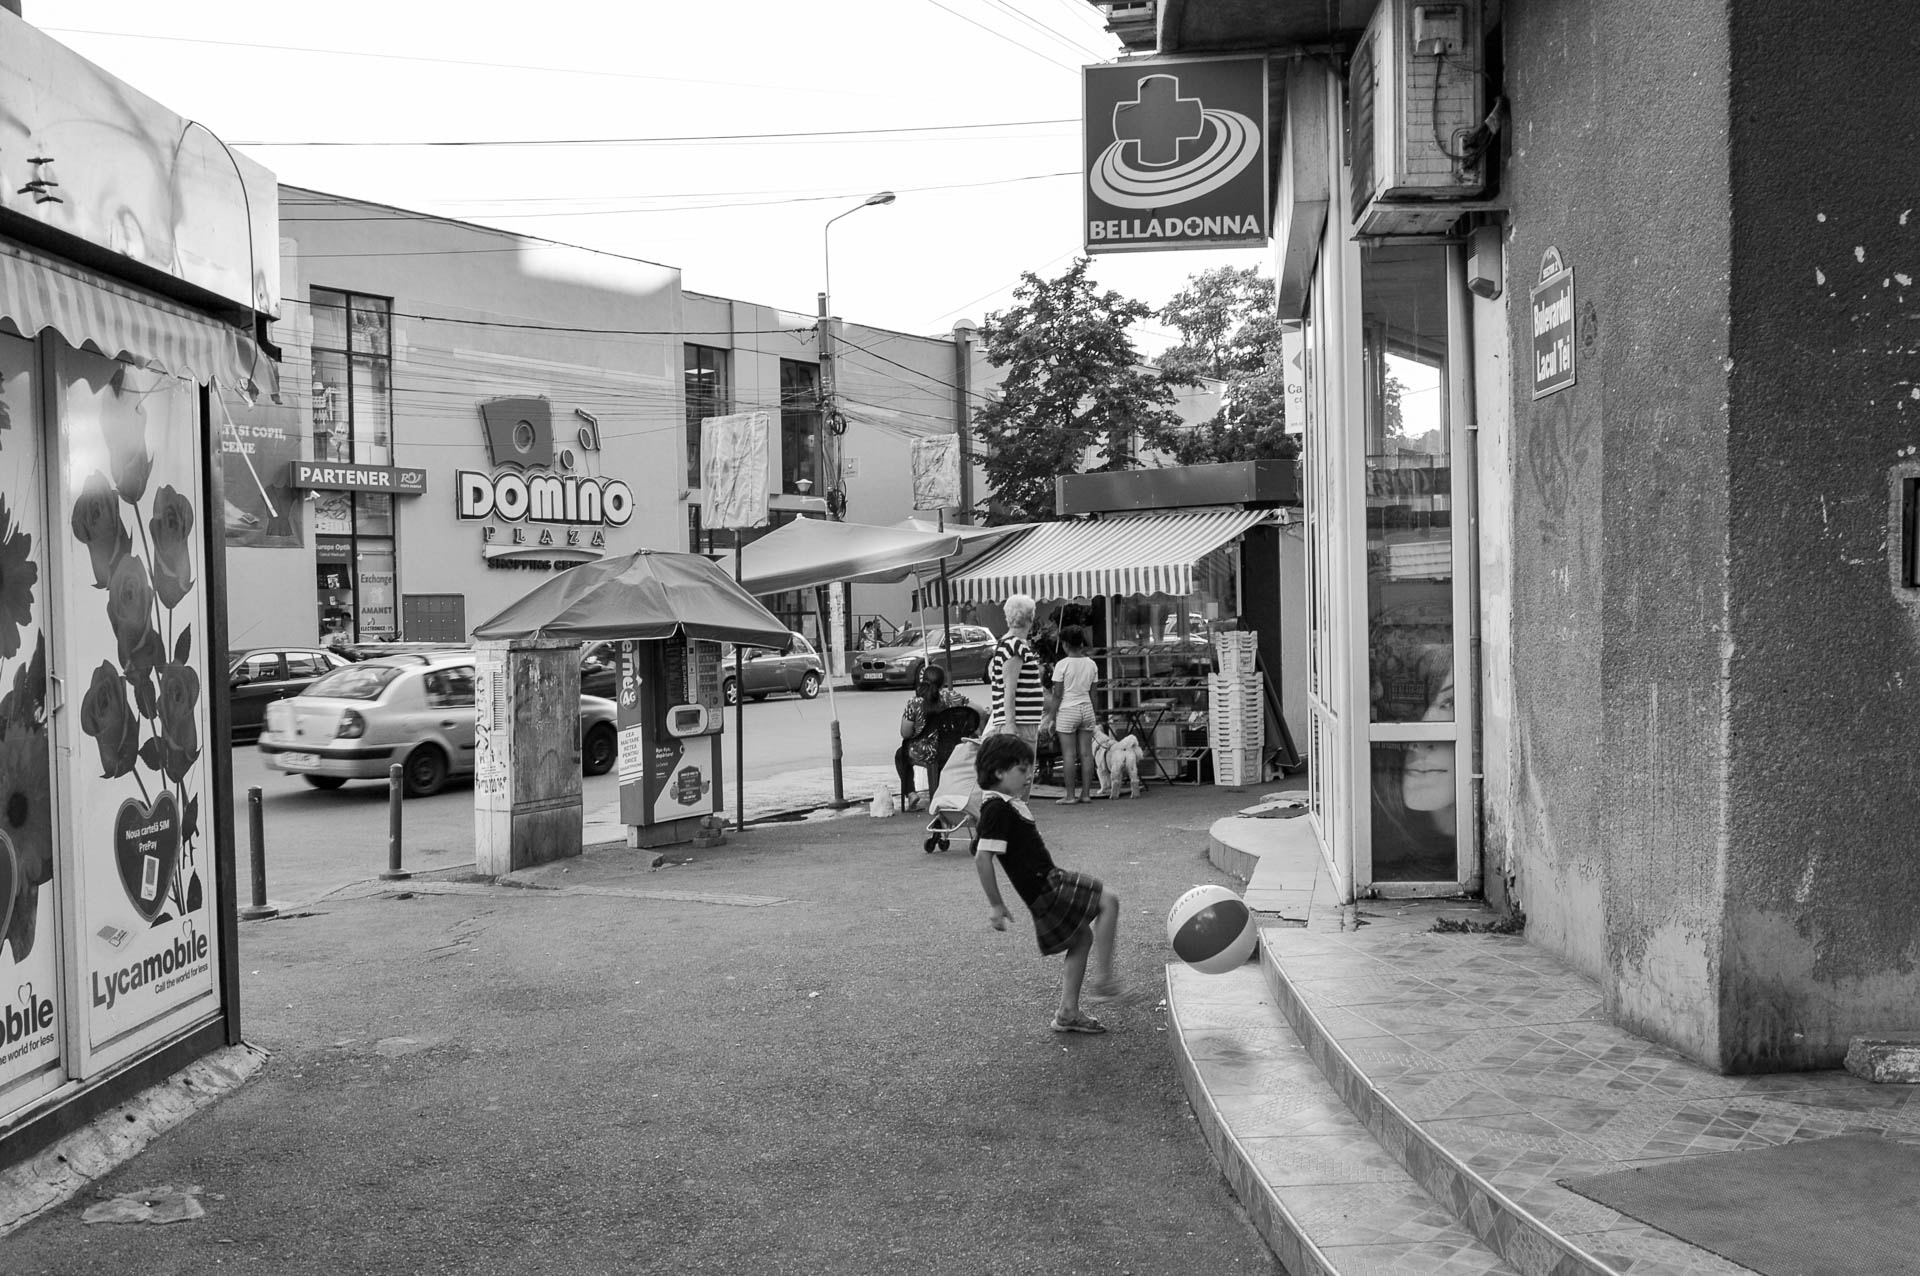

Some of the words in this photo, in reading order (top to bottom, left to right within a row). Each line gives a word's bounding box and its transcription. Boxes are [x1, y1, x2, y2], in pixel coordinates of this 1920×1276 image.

[1090, 215, 1260, 240] BELLADONNA
[1534, 286, 1571, 338] Bulevardul
[1537, 341, 1557, 382] Lacul
[1558, 335, 1571, 373] Tei
[1287, 383, 1303, 395] Ca
[300, 467, 390, 486] PARTENER
[483, 526, 606, 546] PLAZA
[488, 558, 552, 570] SHOPPING
[360, 574, 392, 586] Exchange
[361, 607, 393, 615] AMANET
[622, 691, 637, 707] 4G
[125, 828, 141, 840] Noua
[159, 819, 170, 831] SIM
[139, 840, 158, 853] PrePay
[92, 929, 208, 1010] Lycamobile
[155, 982, 166, 994] Call
[166, 978, 175, 988] the
[176, 970, 190, 986] world
[190, 966, 198, 977] for
[198, 963, 208, 975] less
[8, 1042, 29, 1061] world
[29, 1040, 40, 1052] for
[40, 1033, 55, 1047] less
